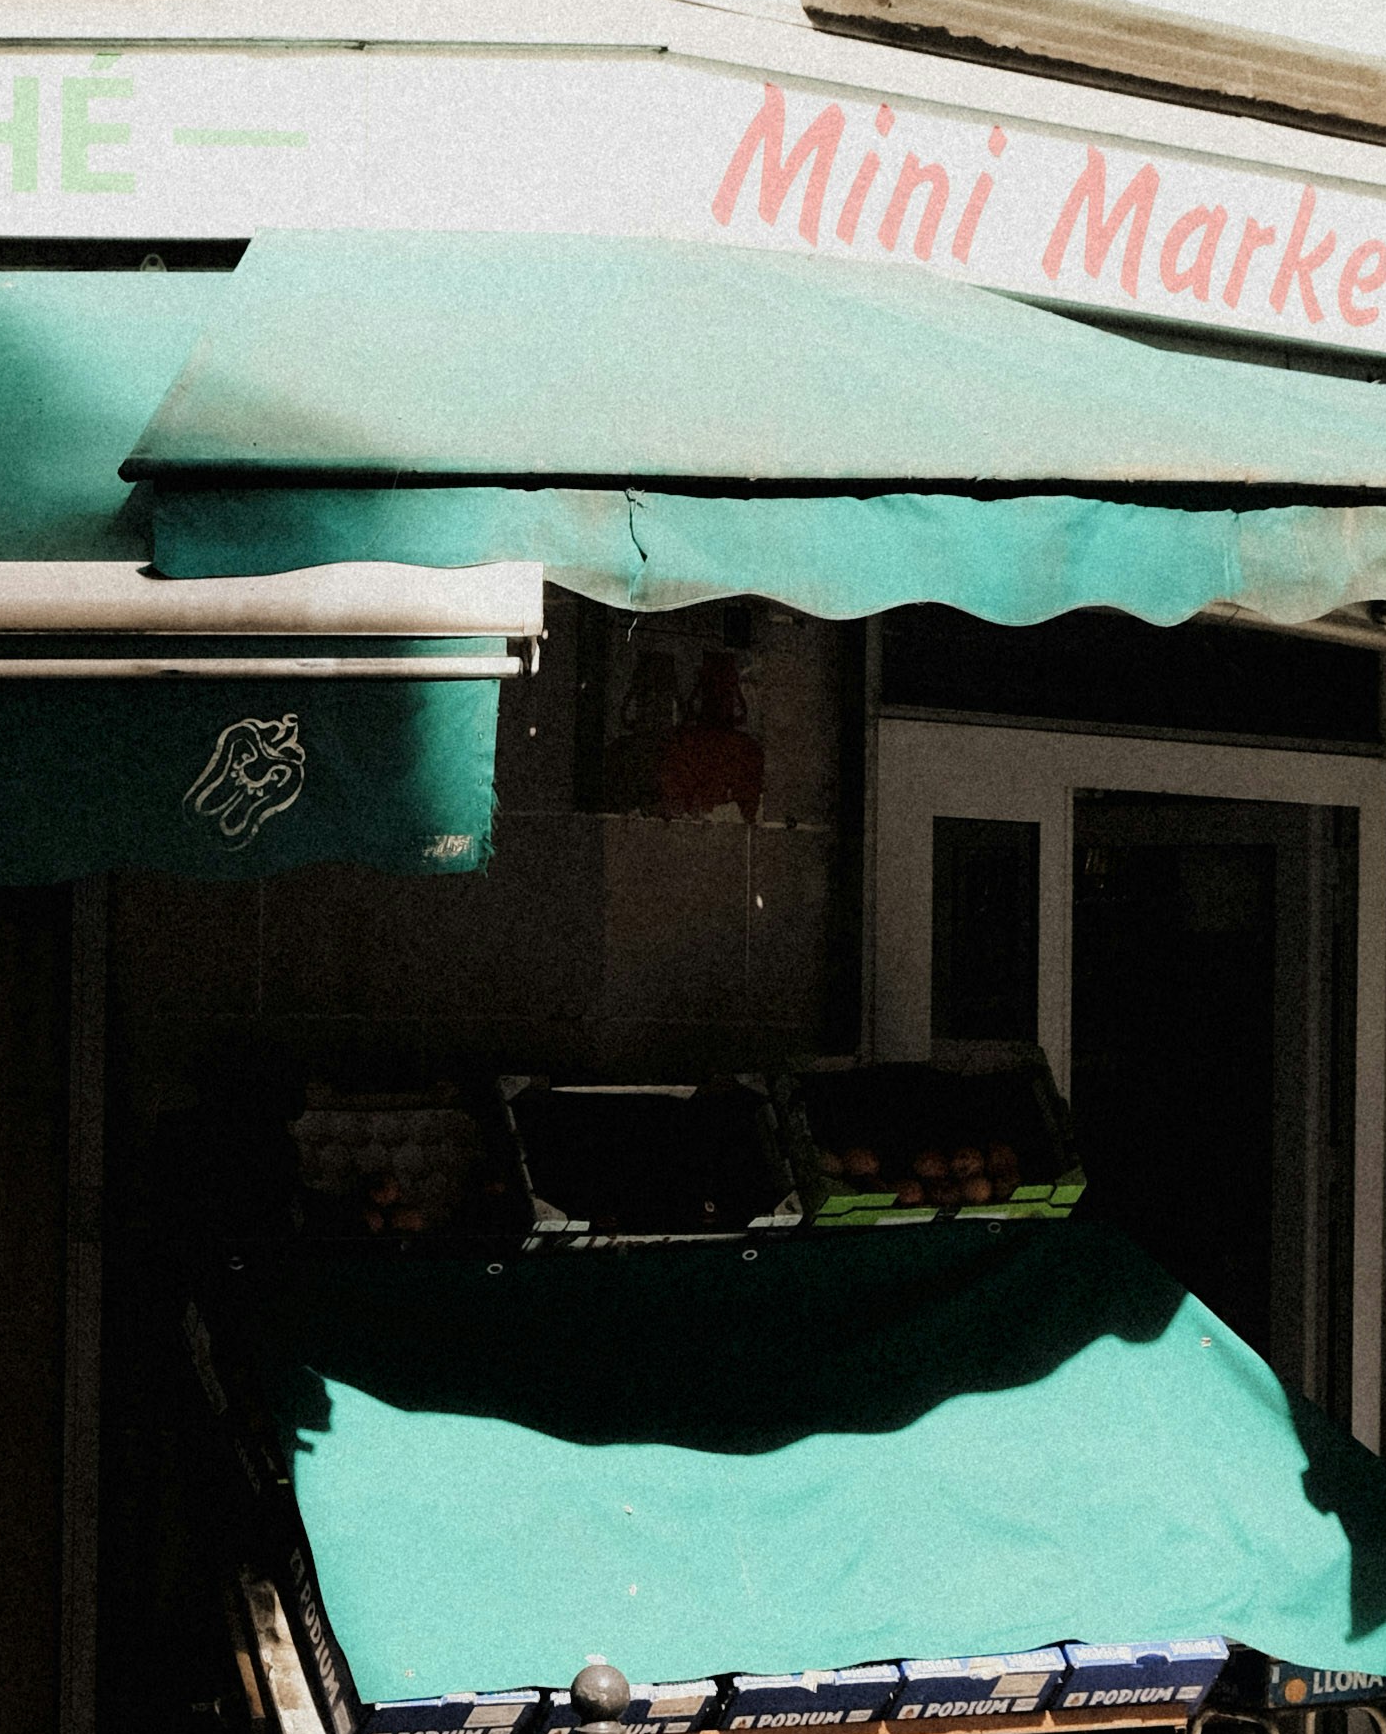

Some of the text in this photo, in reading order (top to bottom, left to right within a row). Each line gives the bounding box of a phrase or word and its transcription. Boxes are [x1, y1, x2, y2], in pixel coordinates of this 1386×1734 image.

[711, 81, 1007, 265] Mini
[299, 1579, 341, 1707] PODIUM
[1088, 1686, 1175, 1706] PODIUM
[756, 1710, 845, 1728] PODIUM
[923, 1698, 1012, 1719] PODIUM
